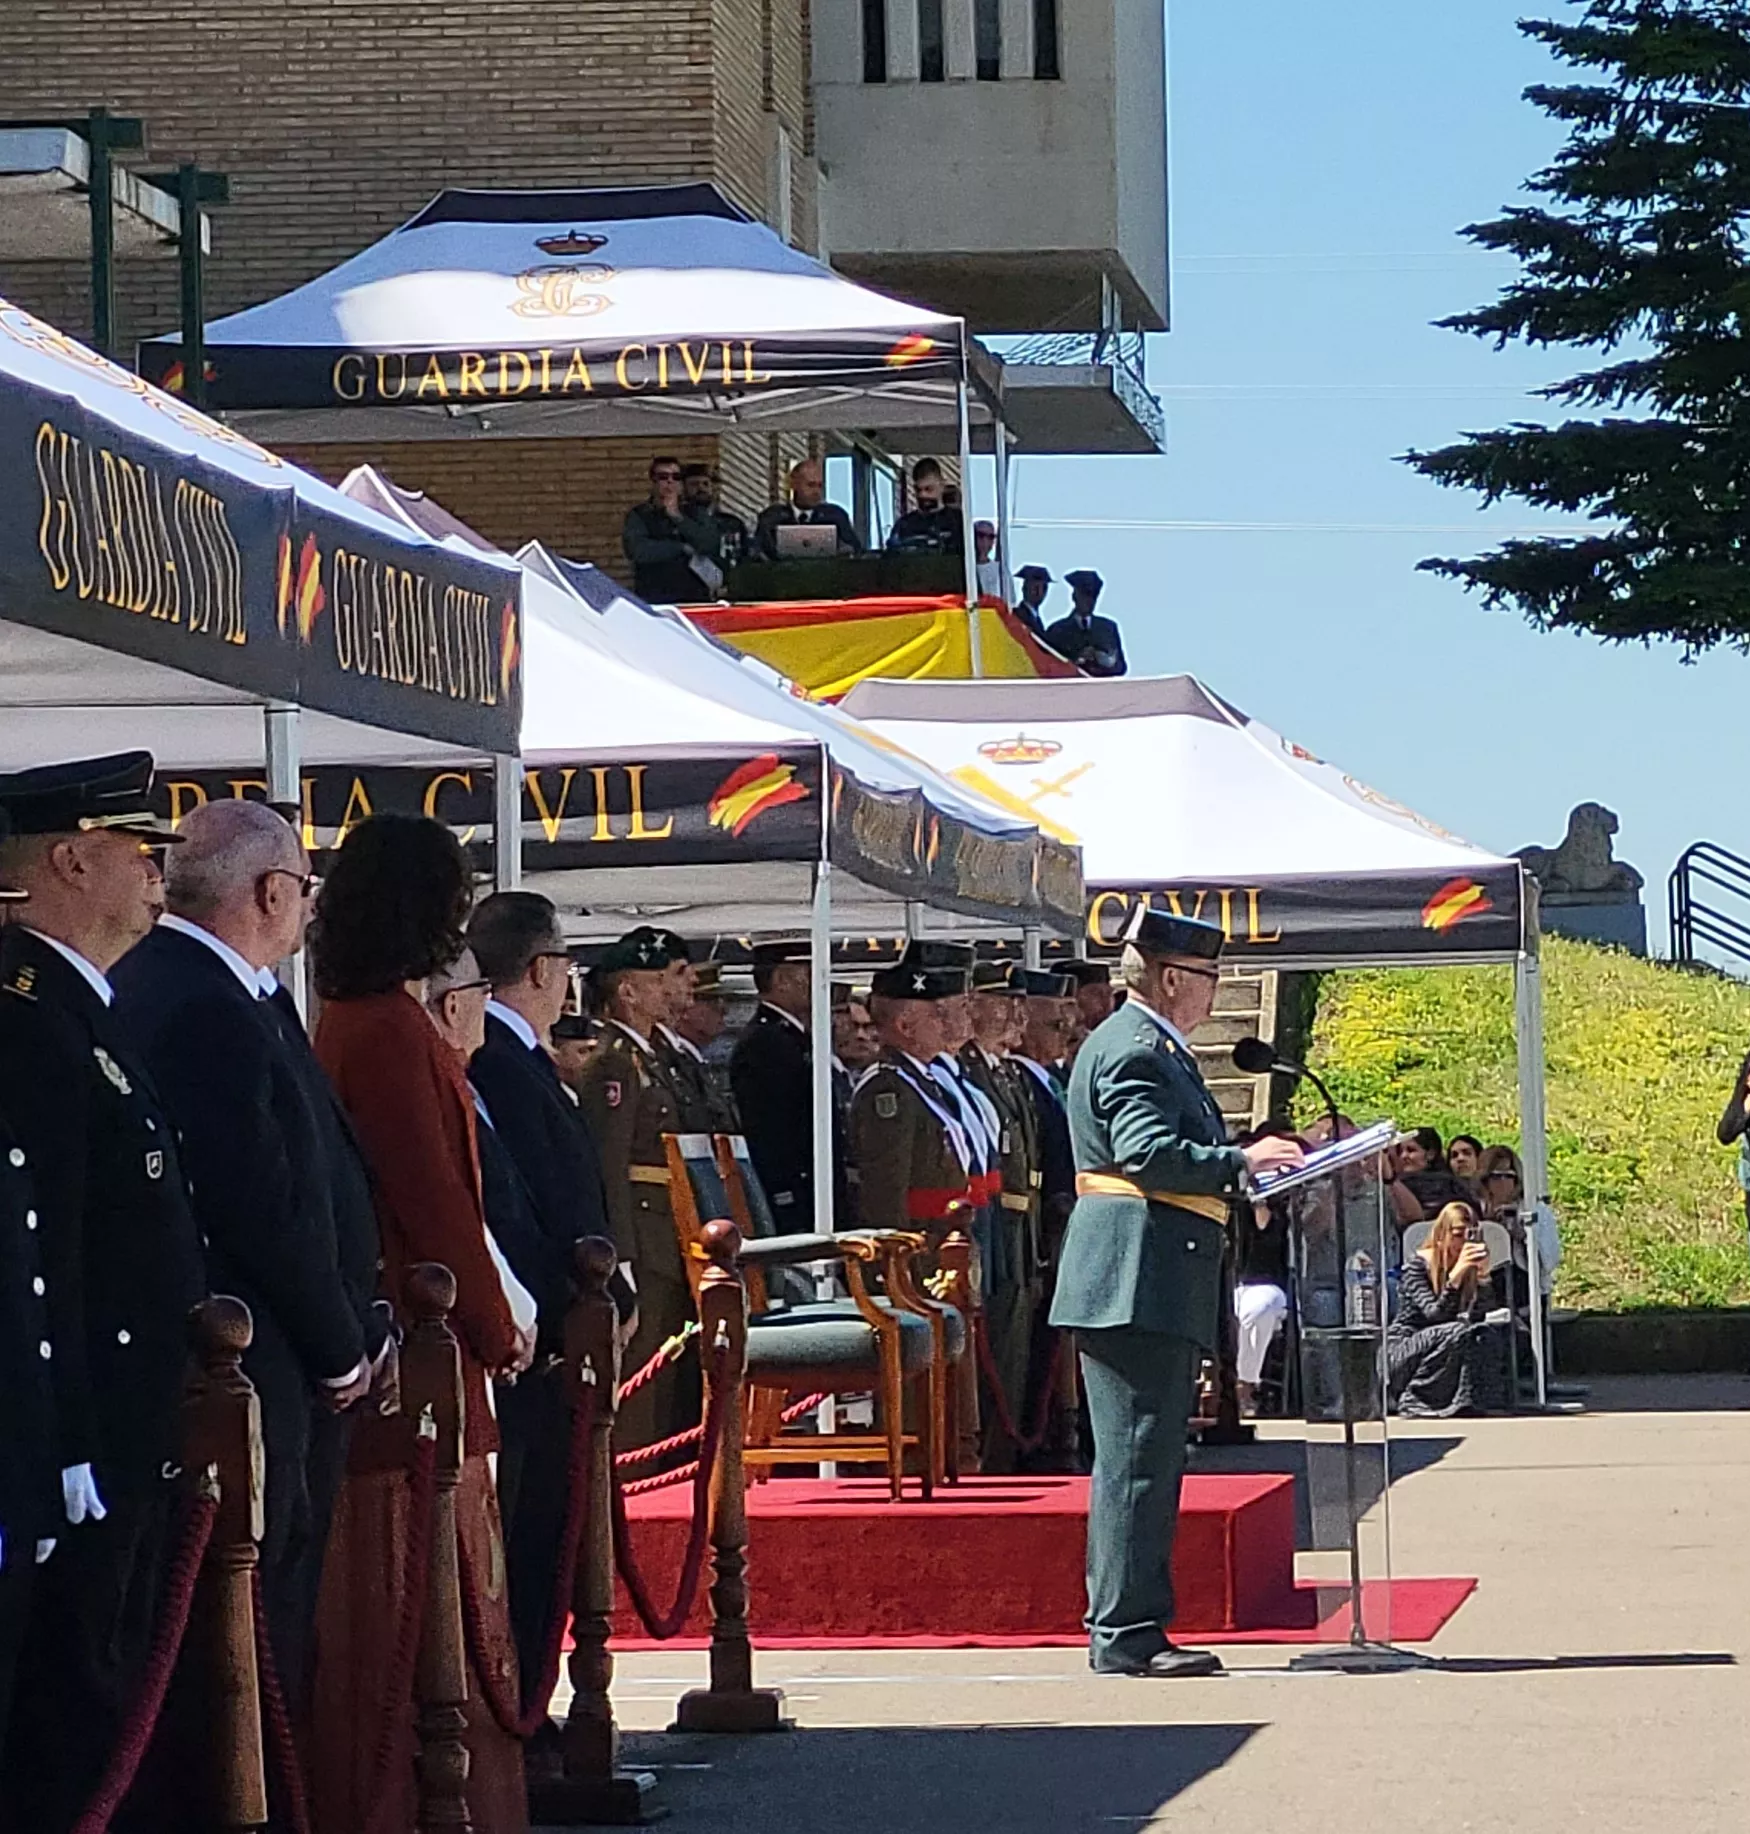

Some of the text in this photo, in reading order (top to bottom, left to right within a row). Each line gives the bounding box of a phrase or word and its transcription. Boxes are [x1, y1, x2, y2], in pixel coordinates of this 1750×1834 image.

[332, 339, 772, 400] GUARDIA CIVIL
[35, 422, 247, 645] GUARDIA CIVIL
[333, 548, 497, 705] GUARDIA CIVIL
[423, 765, 675, 847] CVIL
[1088, 888, 1283, 946] CVIL
